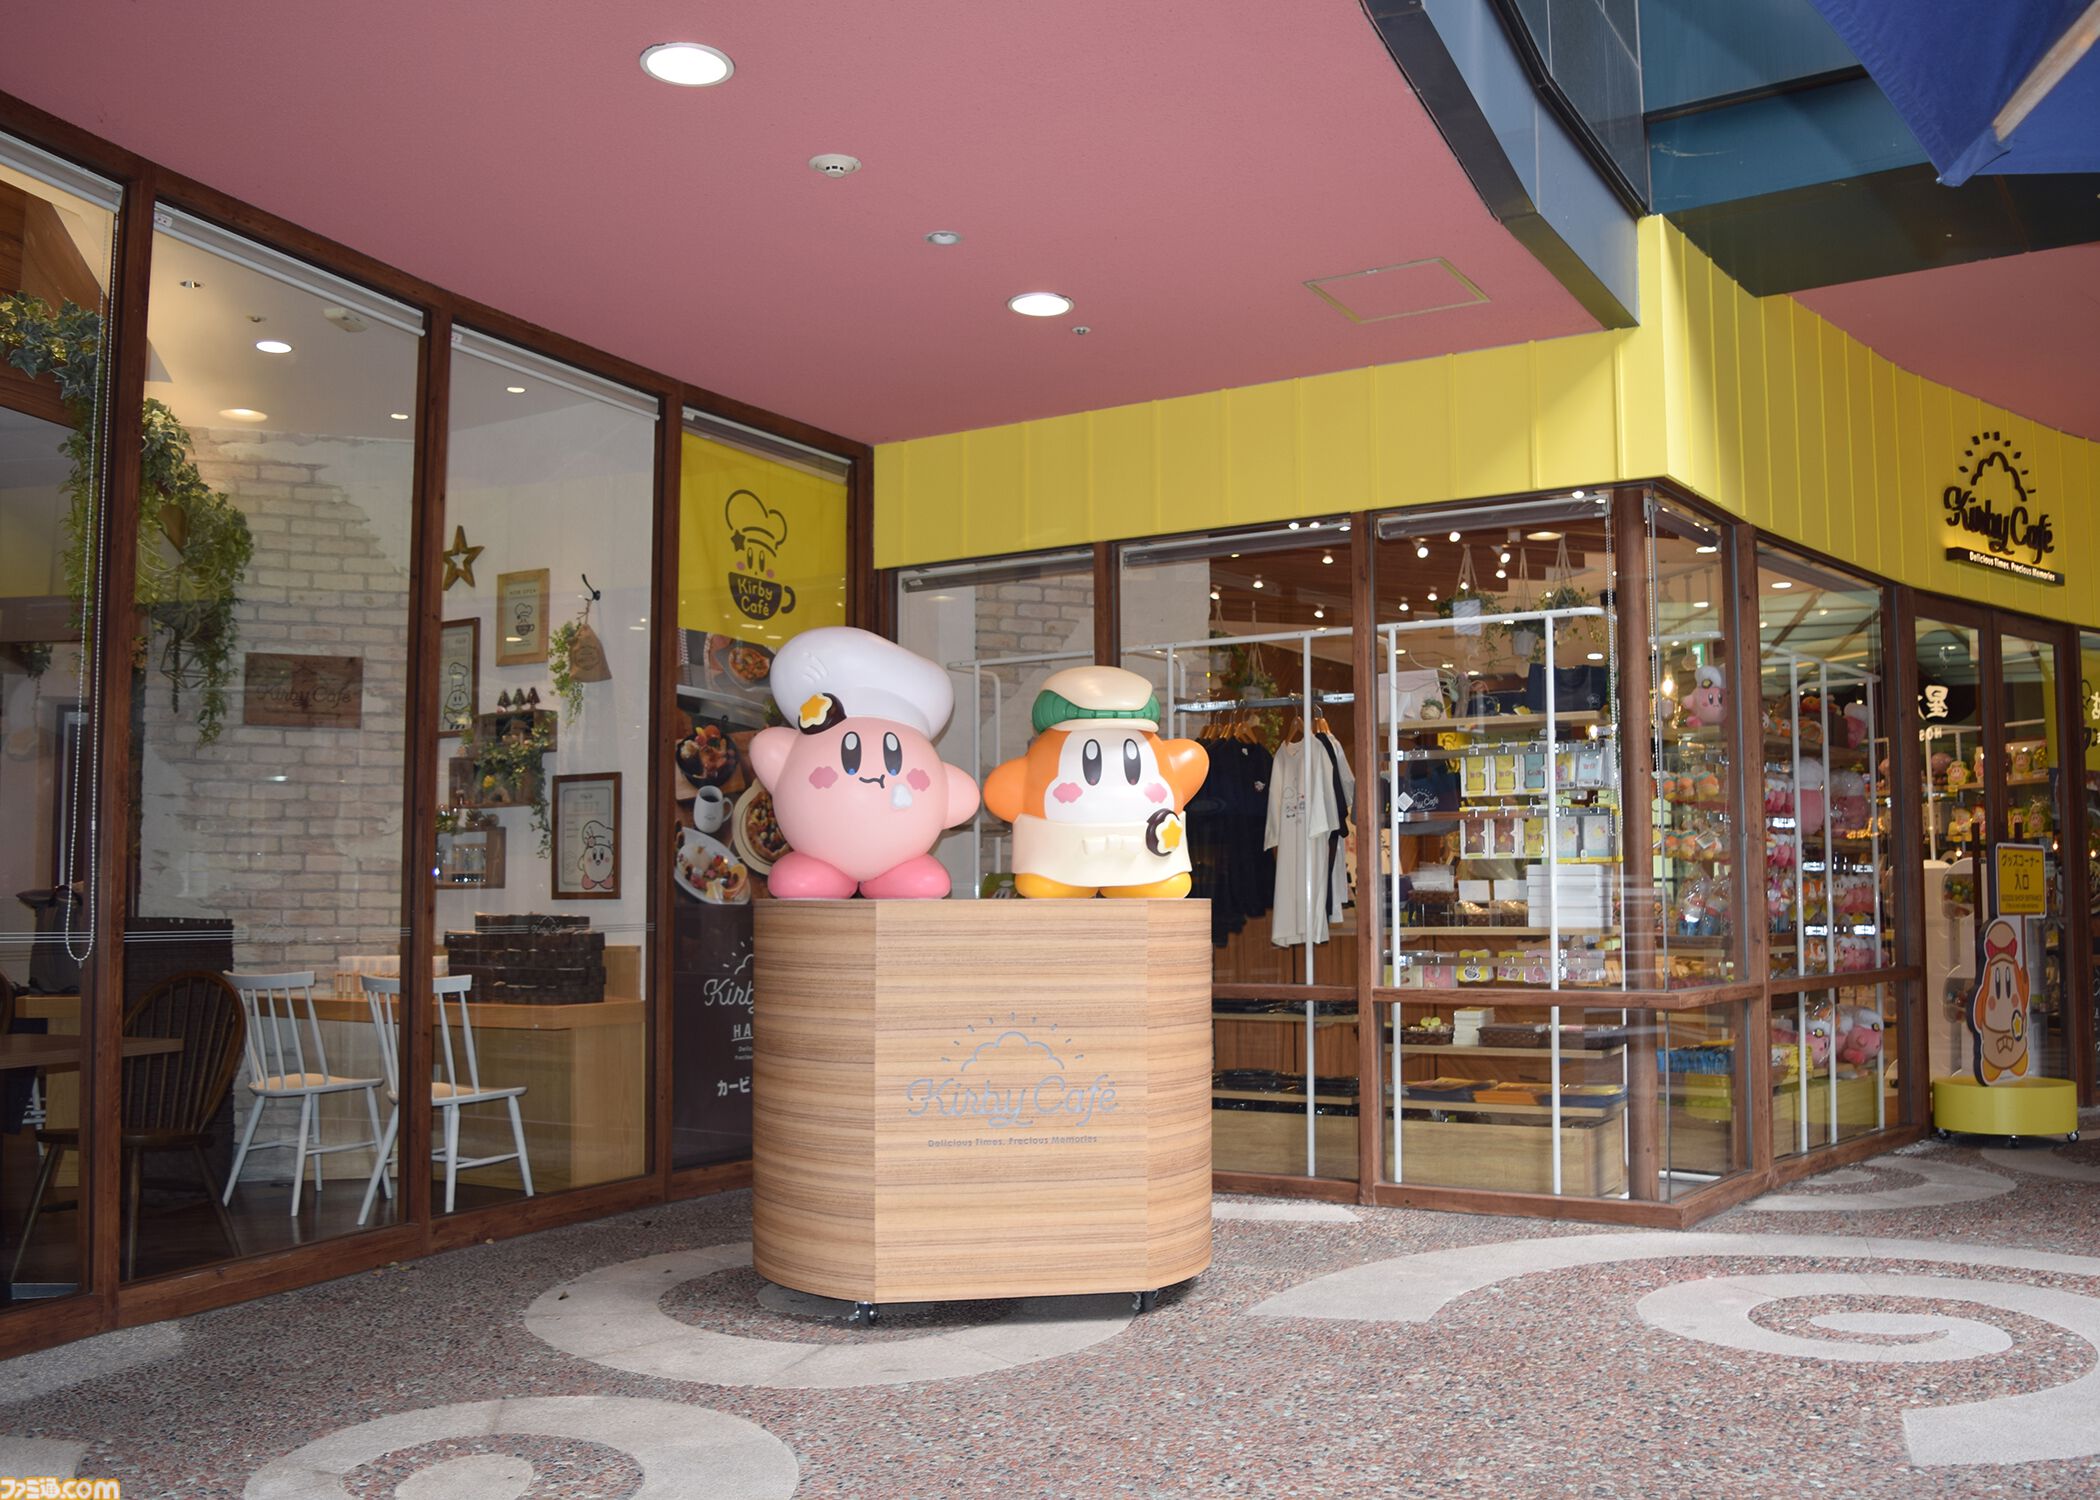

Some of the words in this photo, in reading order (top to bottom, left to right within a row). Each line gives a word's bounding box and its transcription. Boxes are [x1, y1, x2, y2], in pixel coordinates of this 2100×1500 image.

[1943, 486, 2014, 555] Kirby
[737, 578, 774, 601] Kirby
[740, 595, 770, 617] Café
[2001, 853, 2040, 867] グッズコーナー
[2015, 873, 2030, 891] 入口
[905, 1077, 1033, 1129] Kirby
[927, 1139, 973, 1148] Delicious
[1008, 1136, 1049, 1146] Precious
[1050, 1134, 1098, 1145] Memories
